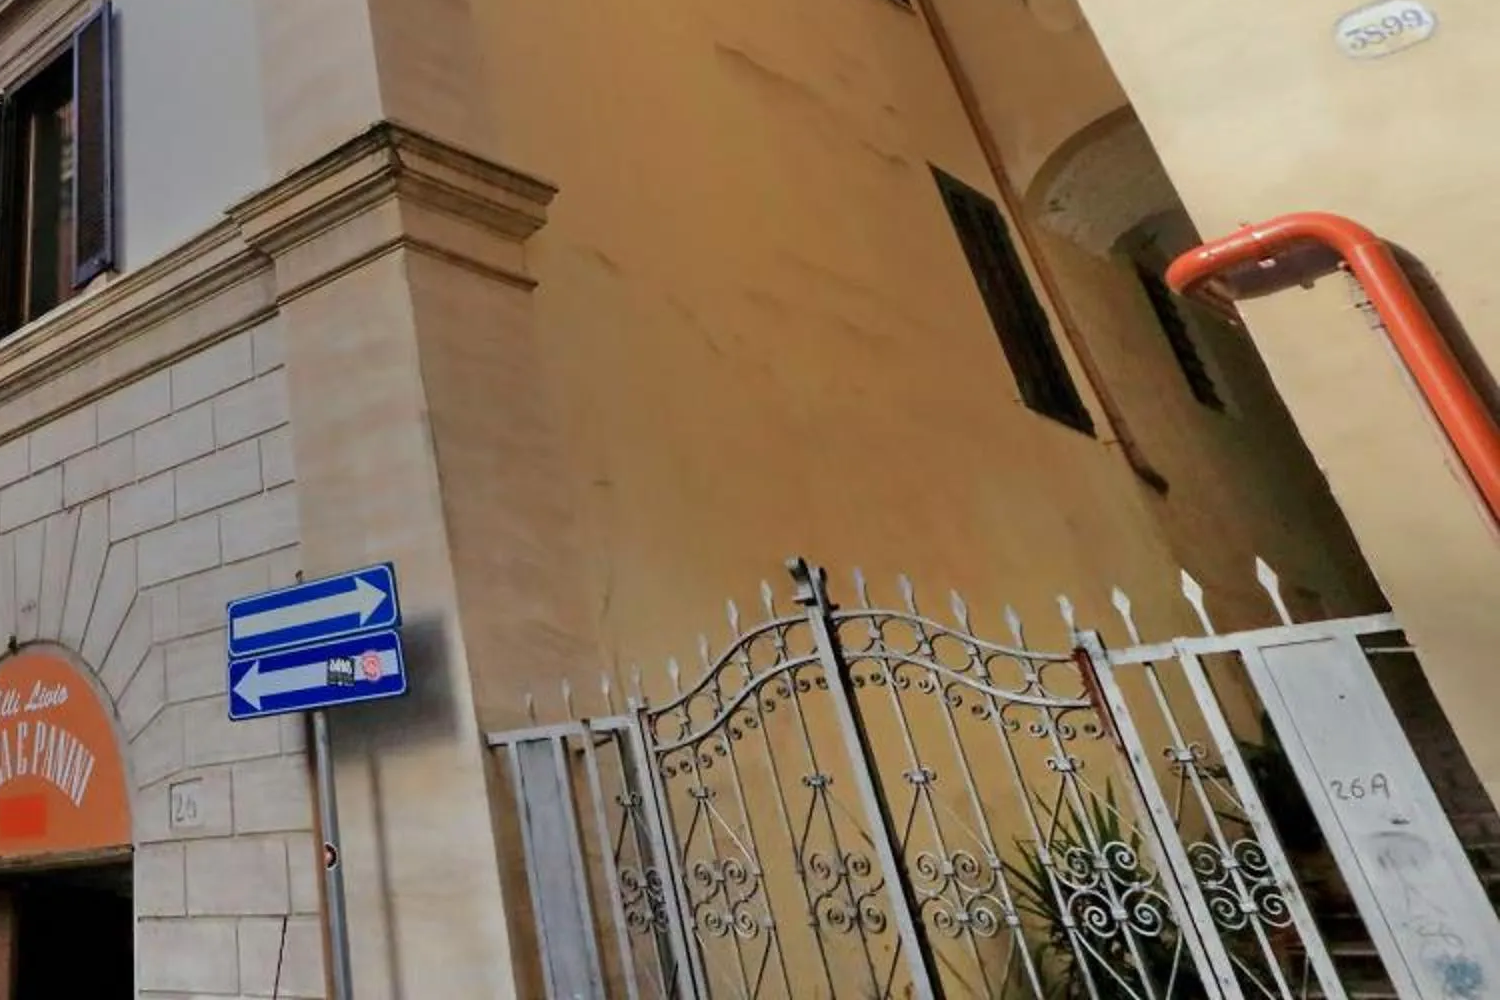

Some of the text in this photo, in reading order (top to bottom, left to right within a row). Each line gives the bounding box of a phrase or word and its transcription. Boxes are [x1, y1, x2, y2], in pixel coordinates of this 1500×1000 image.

[24, 679, 68, 712] Livio
[16, 721, 28, 775] E
[31, 719, 96, 808] PANINI
